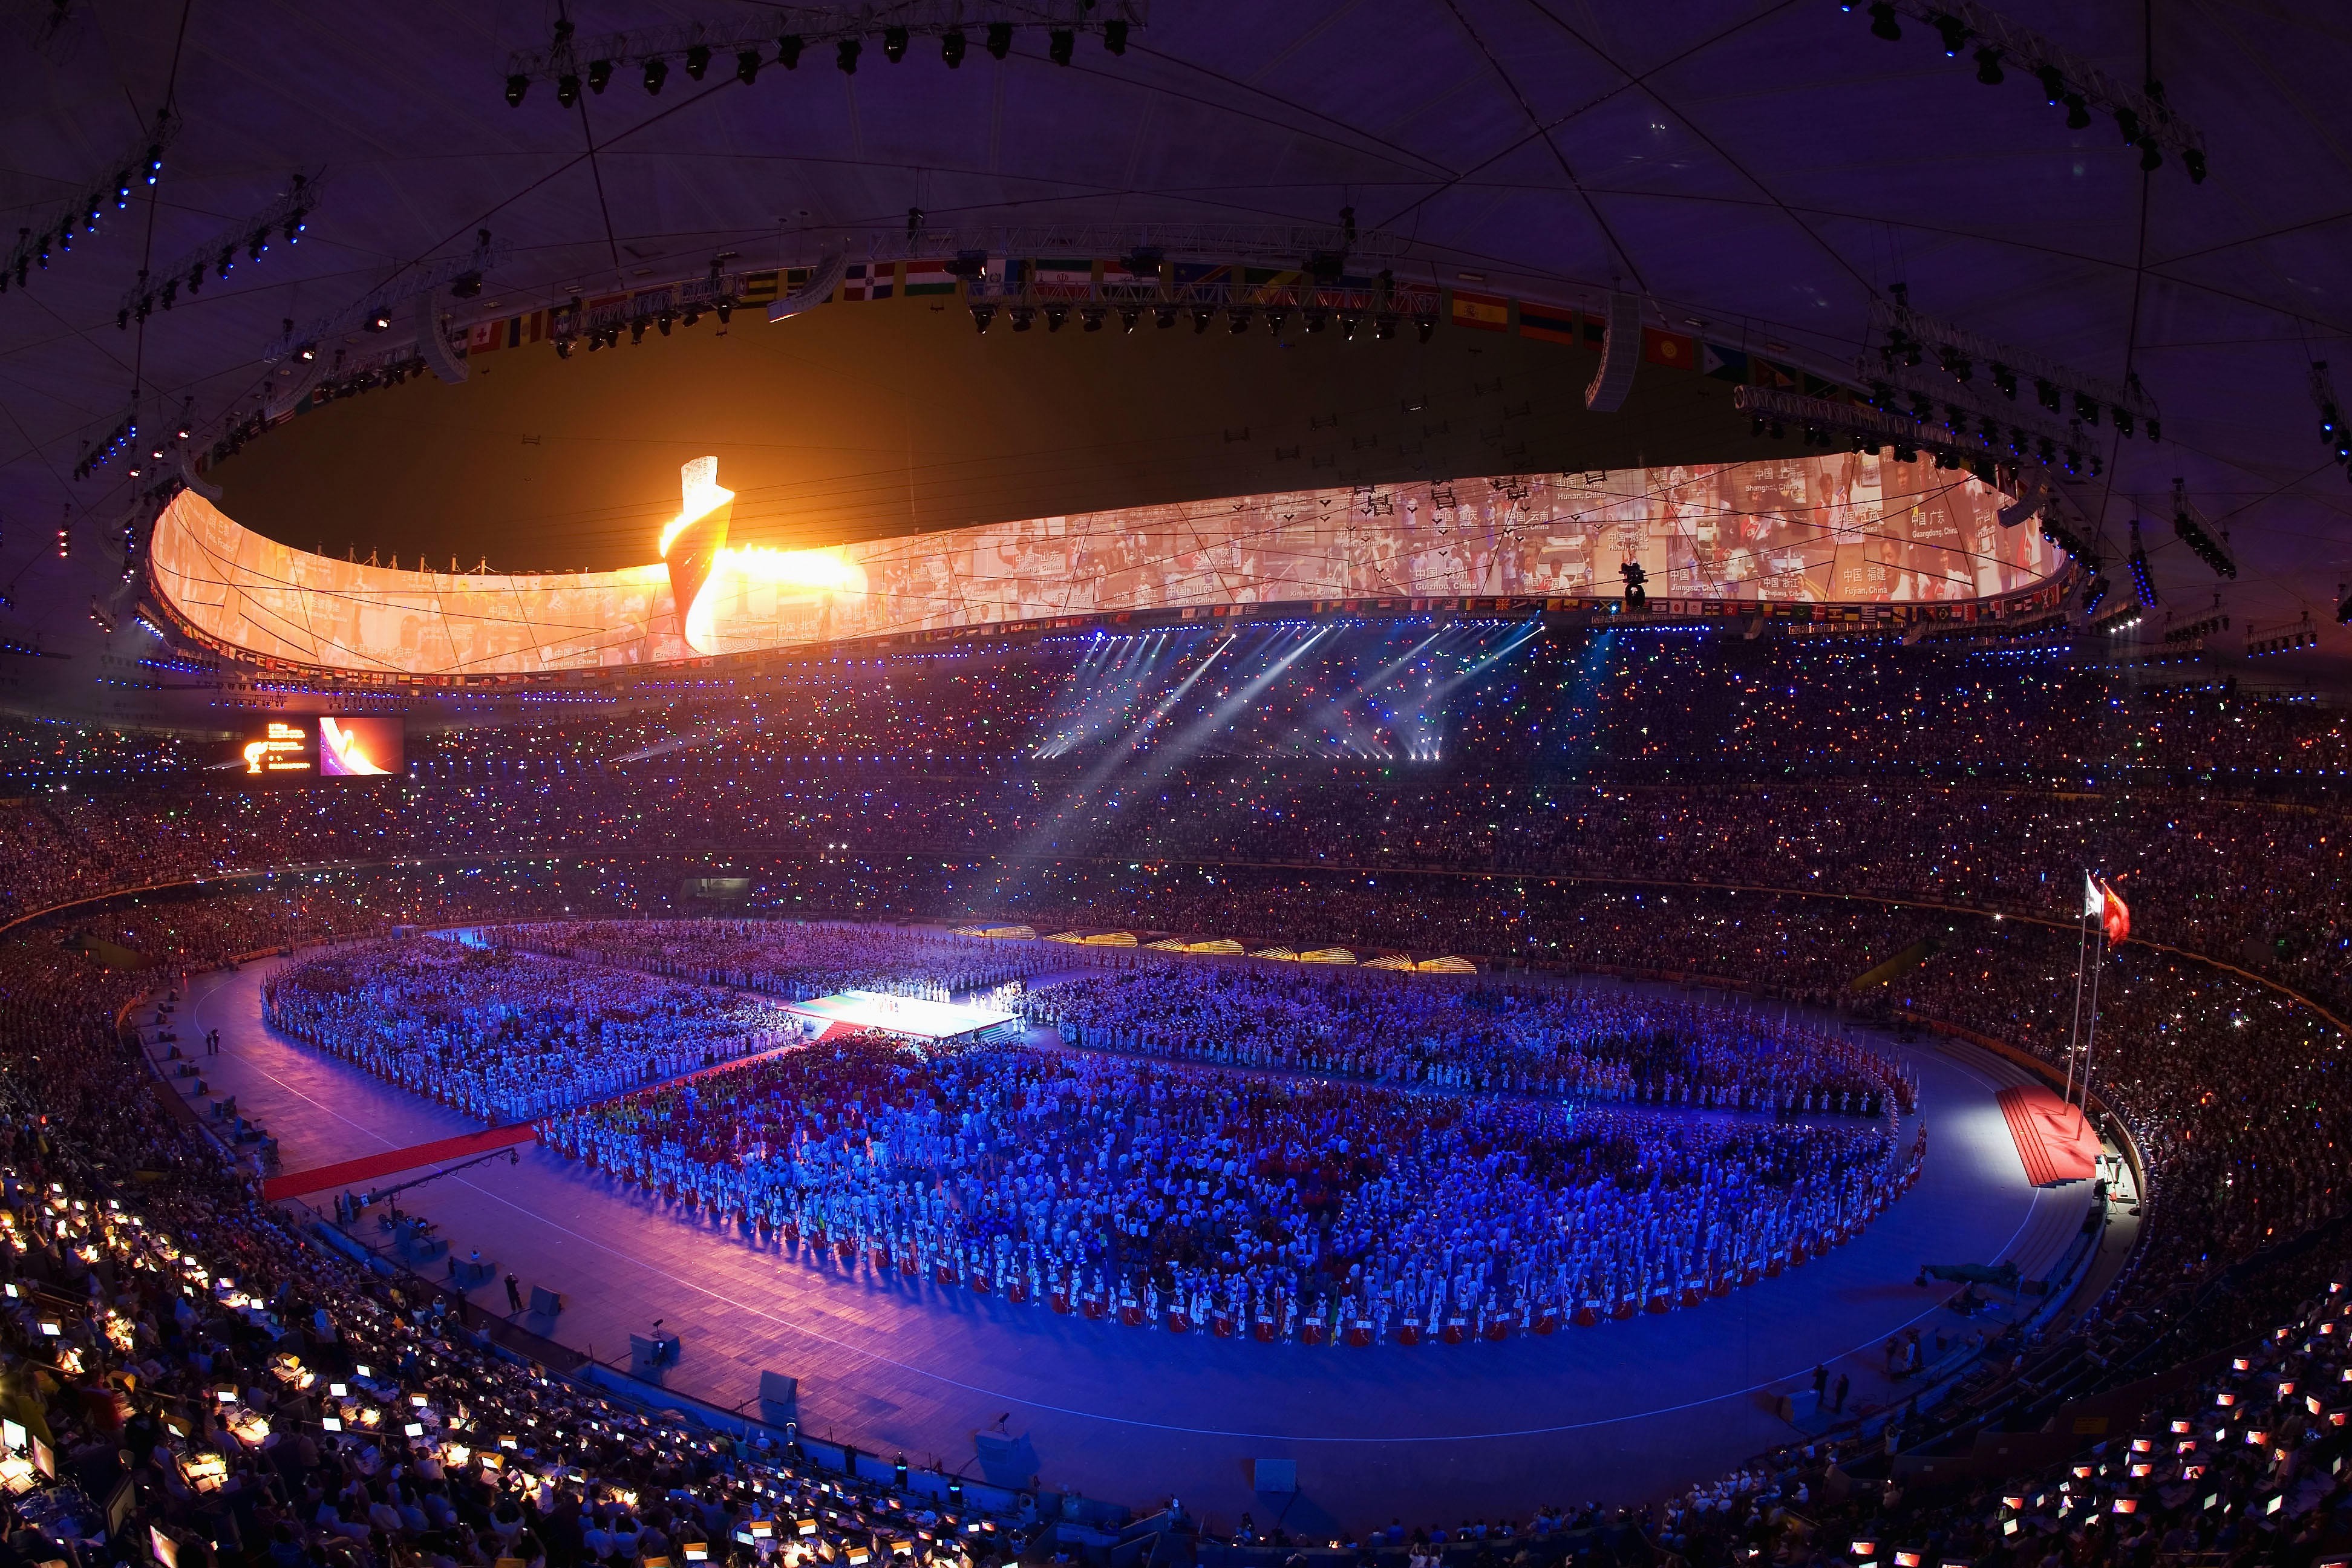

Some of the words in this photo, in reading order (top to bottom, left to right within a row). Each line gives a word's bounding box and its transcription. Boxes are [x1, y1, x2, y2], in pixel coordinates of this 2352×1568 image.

[1755, 468, 1773, 480] 中国
[1778, 466, 1797, 479] 上海
[1556, 478, 1576, 490] 中国
[1437, 512, 1453, 521] 中国
[1459, 511, 1477, 521] 重庆
[1509, 512, 1525, 524] 中国
[1530, 511, 1549, 521] 云南
[1838, 511, 1855, 526] 中国
[1912, 512, 1926, 527] 中国
[1930, 509, 1945, 525] 广东
[1608, 532, 1625, 543] 中国
[1630, 532, 1648, 543] 湖北
[1912, 529, 1944, 539] Guangdong,
[1944, 527, 1959, 535] China
[1016, 552, 1034, 565] 中国
[1040, 550, 1060, 562] 山东
[1200, 549, 1216, 559] 中国
[1003, 566, 1040, 575] Shandong,
[1416, 567, 1439, 581] 中国
[1446, 566, 1468, 580] 贵州
[1670, 569, 1690, 581] 中国
[1844, 568, 1863, 583] 中国
[1867, 567, 1886, 582] 福建
[1298, 578, 1314, 588] 中国
[1416, 583, 1451, 591] Guizhou,
[1524, 577, 1539, 587] 中国
[1763, 577, 1779, 587] 中国
[1782, 577, 1798, 588] 浙江
[1166, 585, 1187, 597] 中国
[1194, 583, 1214, 595] 山西
[1844, 587, 1868, 596] Fujian,
[1869, 586, 1887, 595] China
[1114, 591, 1129, 601] 中国
[1167, 597, 1195, 606] Shanxi,
[489, 605, 508, 616] 中国
[514, 607, 534, 617] 北京
[779, 622, 795, 633] 中国
[555, 648, 573, 658] 中国
[578, 647, 596, 656] 北京
